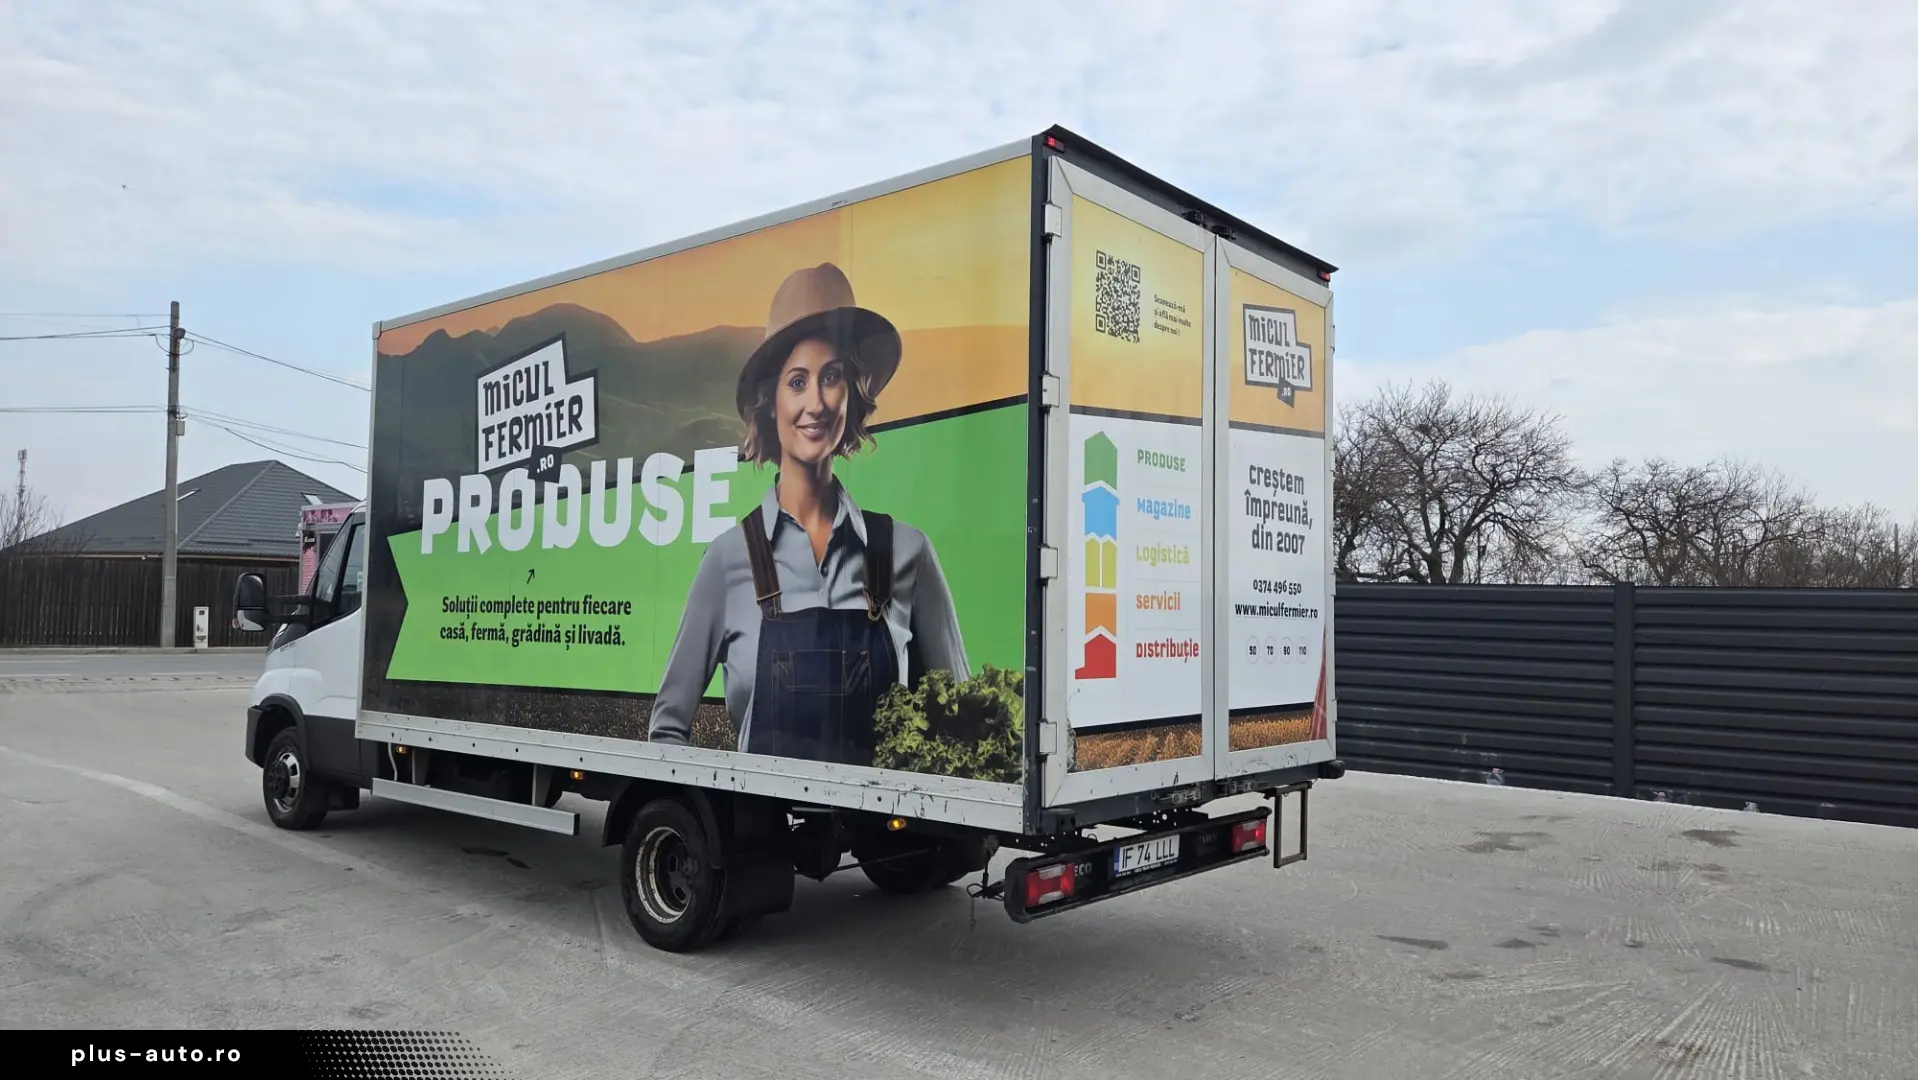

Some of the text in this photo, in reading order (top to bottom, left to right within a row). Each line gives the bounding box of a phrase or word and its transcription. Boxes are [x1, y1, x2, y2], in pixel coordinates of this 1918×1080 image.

[1137, 449, 1186, 473] PRODUSE
[1249, 465, 1304, 497] creștem
[421, 446, 739, 555] PRODUSE
[1137, 497, 1191, 520] Magazine
[1244, 489, 1313, 530] împreună,
[1252, 523, 1305, 555] din 2007
[1136, 543, 1190, 567] Logistică
[1253, 579, 1302, 595] 0374 496 550
[442, 595, 632, 620] Soluții complete pentru fiecare
[1136, 591, 1181, 611] servicii
[1235, 601, 1318, 619] www.miculfermier.ro
[440, 622, 625, 651] casă, fermă, grădină și livadă.
[1122, 847, 1134, 869] IF
[1137, 843, 1151, 865] 74
[1156, 838, 1175, 860] LLL
